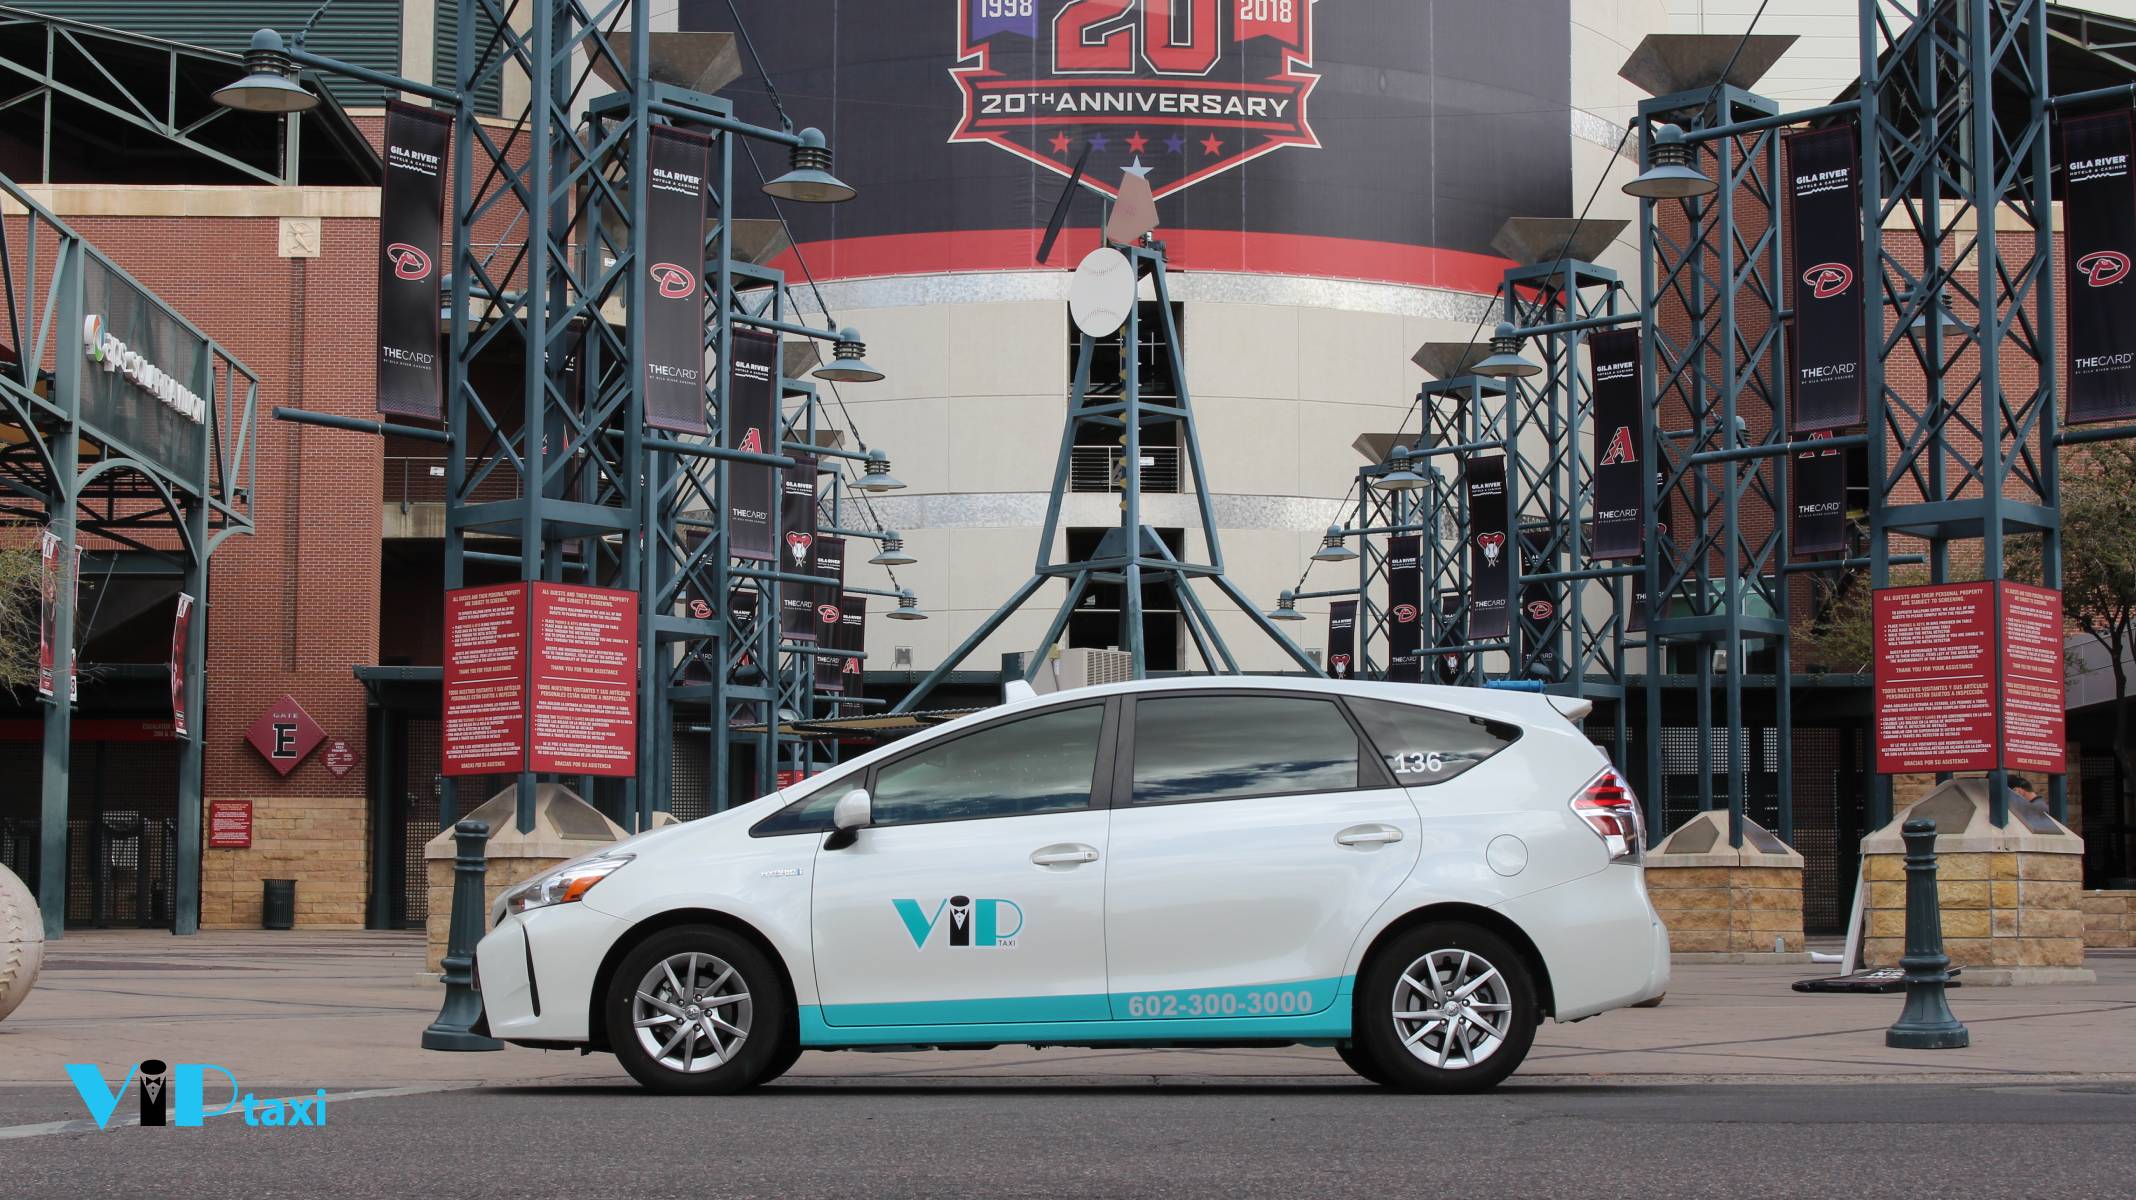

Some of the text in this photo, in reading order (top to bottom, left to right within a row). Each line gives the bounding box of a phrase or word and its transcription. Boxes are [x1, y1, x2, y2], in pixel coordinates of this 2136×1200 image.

[981, 0, 1033, 18] 1998
[1240, 0, 1293, 23] 2018
[1051, 0, 1221, 75] 20
[1055, 92, 1289, 118] ANNIVERSARY
[390, 145, 438, 165] GILA RIVER
[2069, 155, 2126, 170] GILA RIVER
[653, 168, 700, 185] GILA RIVER
[1796, 168, 1848, 185] GILA RIVER
[1596, 364, 1612, 373] GILA
[1612, 361, 1633, 370] RIVER
[272, 723, 298, 758] E
[1394, 751, 1443, 774] 136
[1128, 991, 1313, 1017] 602-300-3000
